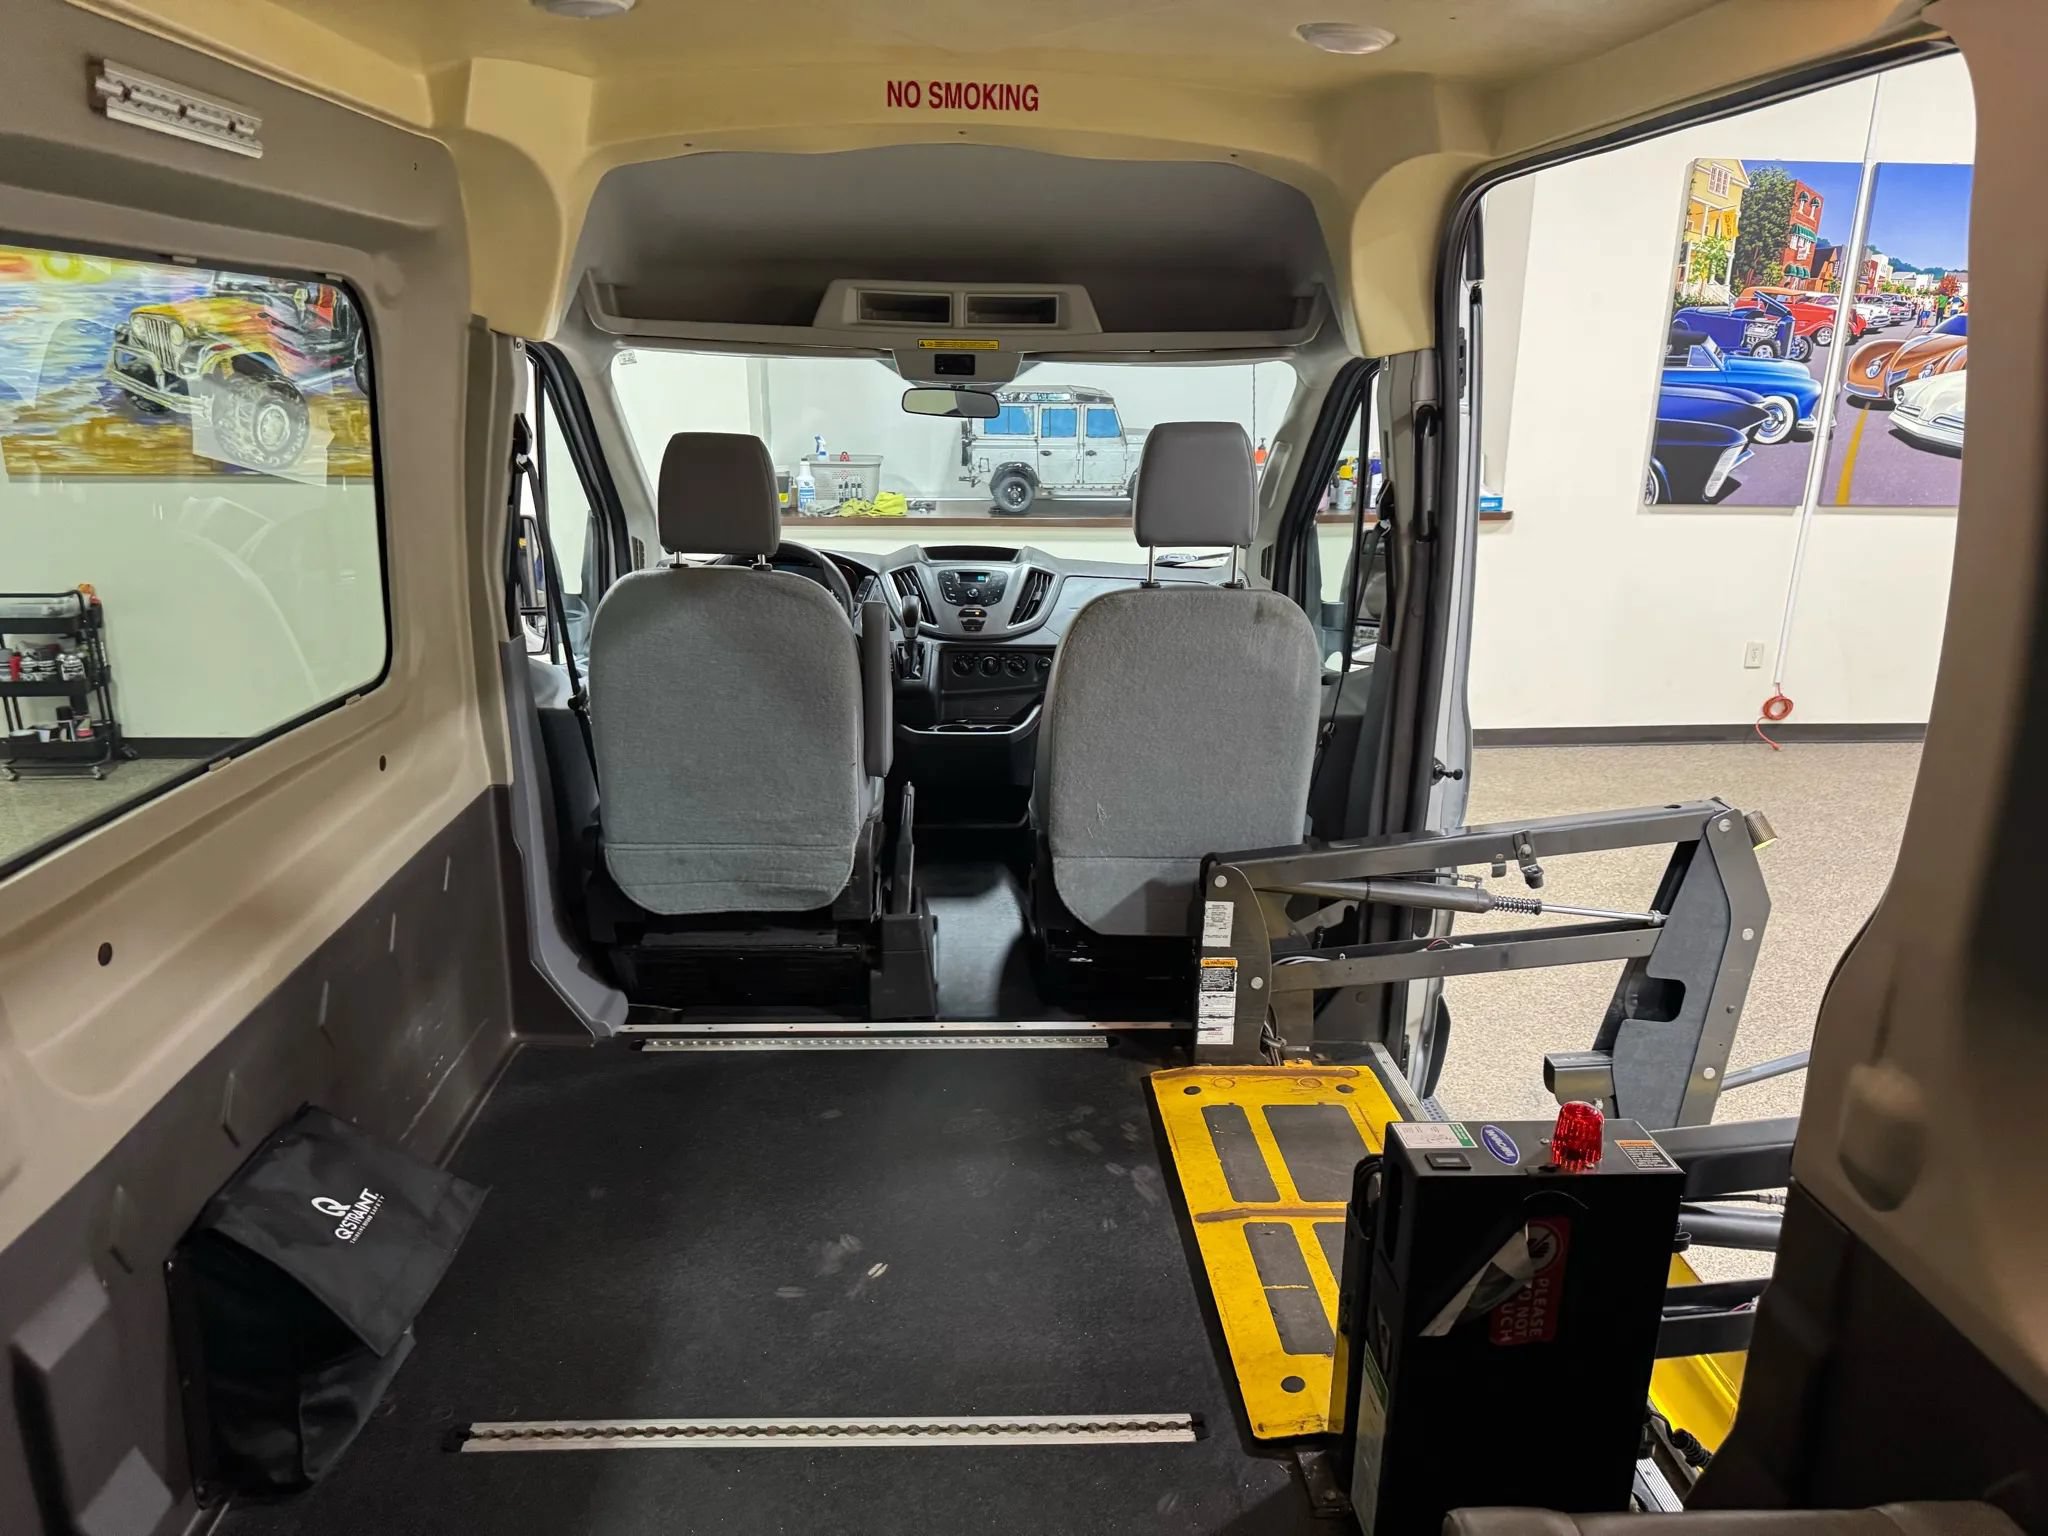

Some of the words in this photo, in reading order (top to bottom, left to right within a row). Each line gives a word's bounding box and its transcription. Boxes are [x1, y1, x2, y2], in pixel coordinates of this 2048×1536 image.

[887, 80, 921, 108] NO
[928, 81, 1039, 112] SMOKING
[1500, 1303, 1514, 1342] UCH
[1516, 1307, 1530, 1336] NOT
[1529, 1279, 1549, 1336] PLEASE
